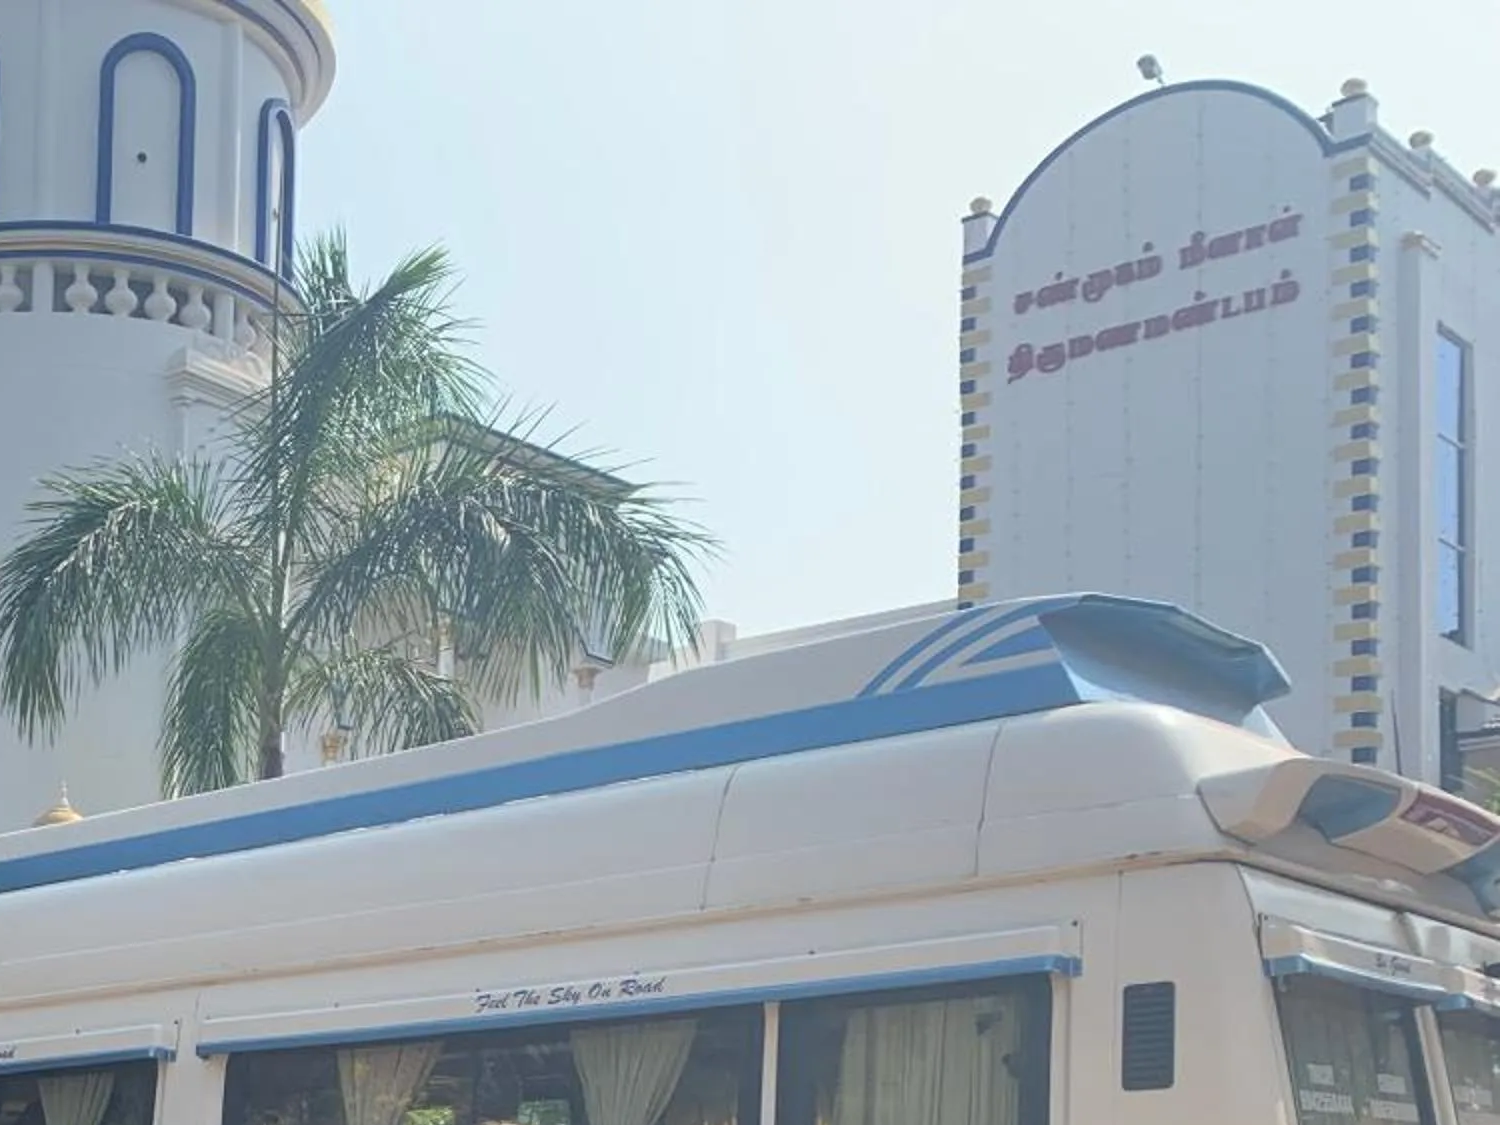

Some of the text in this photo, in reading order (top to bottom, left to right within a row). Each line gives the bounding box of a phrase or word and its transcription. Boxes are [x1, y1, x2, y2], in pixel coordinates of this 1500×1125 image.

[513, 989, 541, 1008] The
[547, 986, 581, 1005] Sky
[588, 981, 611, 999] On
[620, 976, 667, 997] Road
